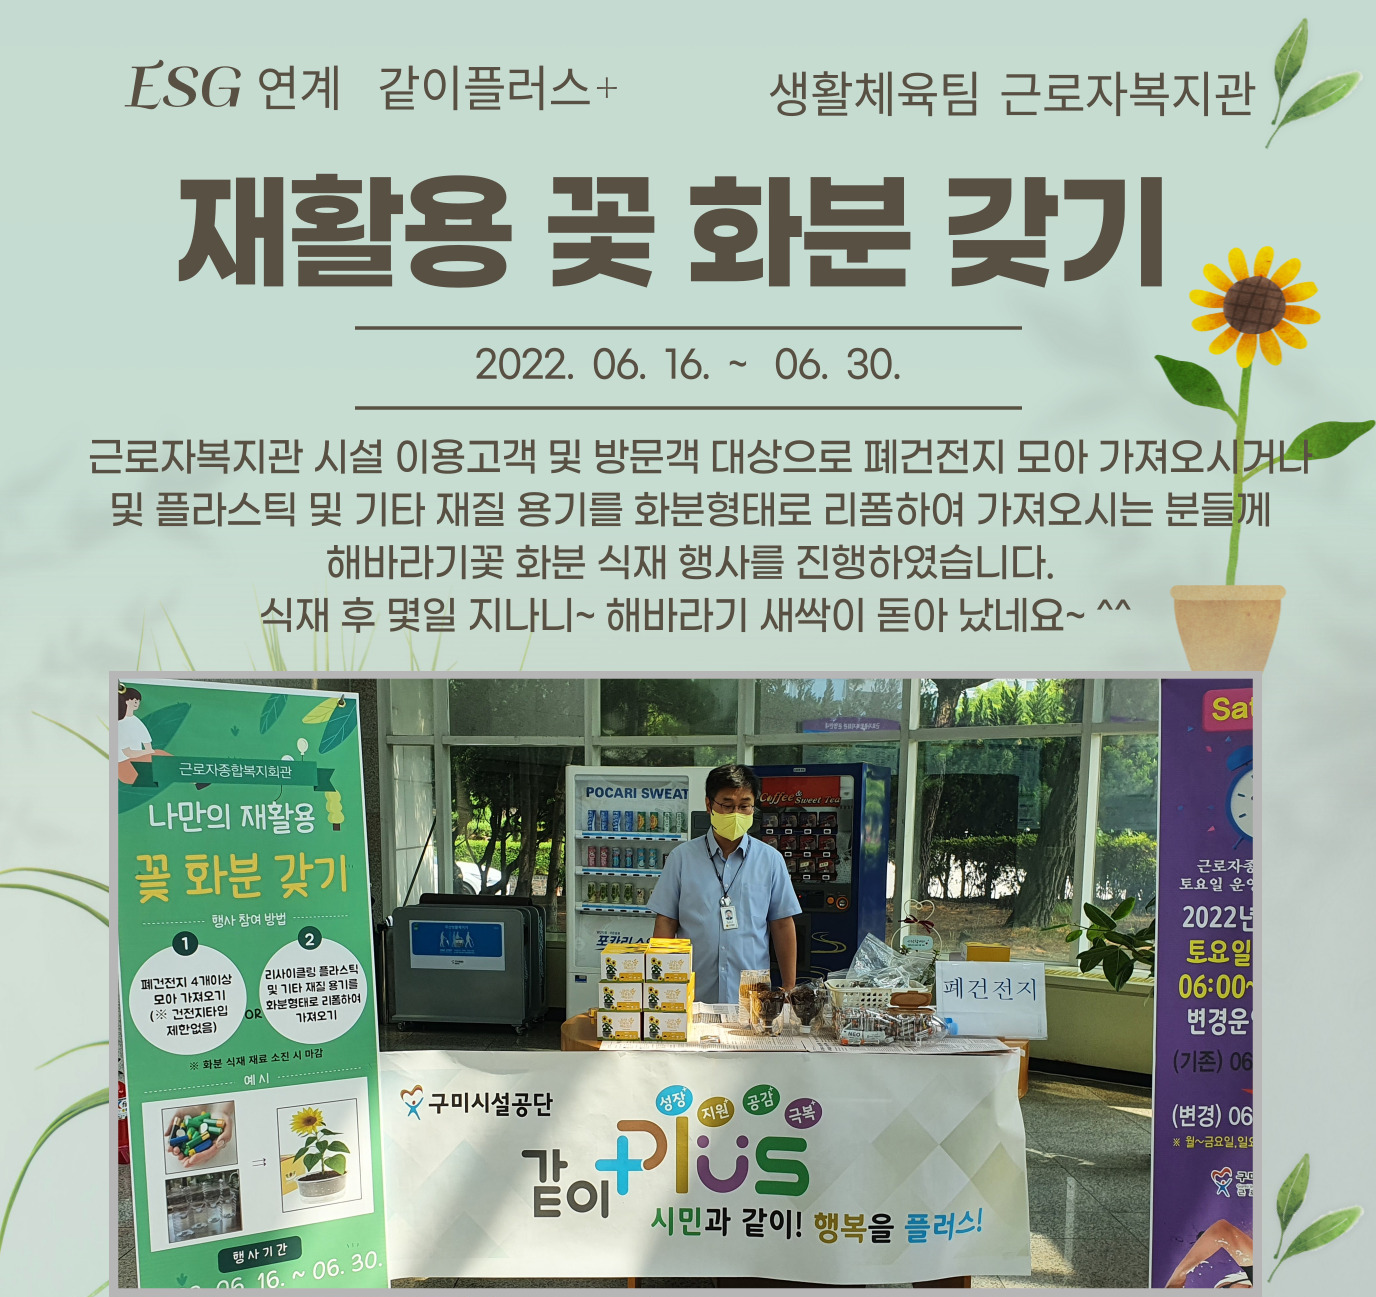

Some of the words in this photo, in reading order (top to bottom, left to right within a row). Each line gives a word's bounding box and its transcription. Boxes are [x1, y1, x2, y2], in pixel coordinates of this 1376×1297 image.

[179, 762, 292, 779] 근로자종합복지회관
[586, 787, 637, 799] POCARI
[641, 788, 689, 800] SWEAT
[760, 792, 795, 805] Coffee
[795, 796, 821, 804] Sweet
[149, 801, 231, 832] 나만의
[241, 801, 315, 835] 재활용
[135, 854, 171, 904] 꽃
[185, 853, 261, 898] 화분
[274, 852, 347, 898] 갖기
[1179, 877, 1223, 892] 토요일
[212, 914, 236, 928] 행사
[239, 913, 261, 927] 참여
[264, 912, 286, 926] 방법
[181, 936, 188, 950] 1
[304, 933, 315, 946] 2
[1186, 939, 1251, 967] 토요일
[265, 966, 316, 980] 리사이클링
[319, 964, 359, 977] 플라스틱
[141, 978, 187, 990] 폐건전지
[191, 974, 232, 986] 4개이상
[267, 984, 278, 995] 및
[282, 982, 302, 993] 기타
[305, 981, 325, 993] 재질
[329, 979, 358, 991] 용기를
[943, 976, 1036, 1001] 폐건전지
[154, 992, 177, 1005] 모아
[181, 990, 226, 1003] 가져오기
[266, 997, 319, 1011] 화분형태로
[322, 994, 361, 1007] 리폼하여
[172, 1005, 228, 1020] 건전지타입
[245, 1009, 262, 1019] OR
[296, 1010, 337, 1023] 가져오기
[166, 1021, 217, 1036] 제한없음)
[1188, 1008, 1253, 1036] 변경운
[203, 1059, 223, 1070] 화분
[226, 1057, 245, 1068] 식재
[249, 1055, 268, 1066] 재료
[271, 1052, 290, 1063] 소진
[293, 1050, 302, 1060] 시
[305, 1048, 323, 1059] 마감
[1173, 1050, 1222, 1074] (기존)
[428, 1092, 553, 1118] 구미시설공단
[1172, 1104, 1222, 1128] (변경)
[521, 1149, 609, 1219] 같이
[651, 1206, 731, 1236] 시민과
[742, 1207, 802, 1239] 같이!
[813, 1211, 895, 1244] 행복을
[904, 1207, 983, 1243] 플러스!
[312, 1258, 344, 1280] 06.
[352, 1250, 383, 1272] 30.
